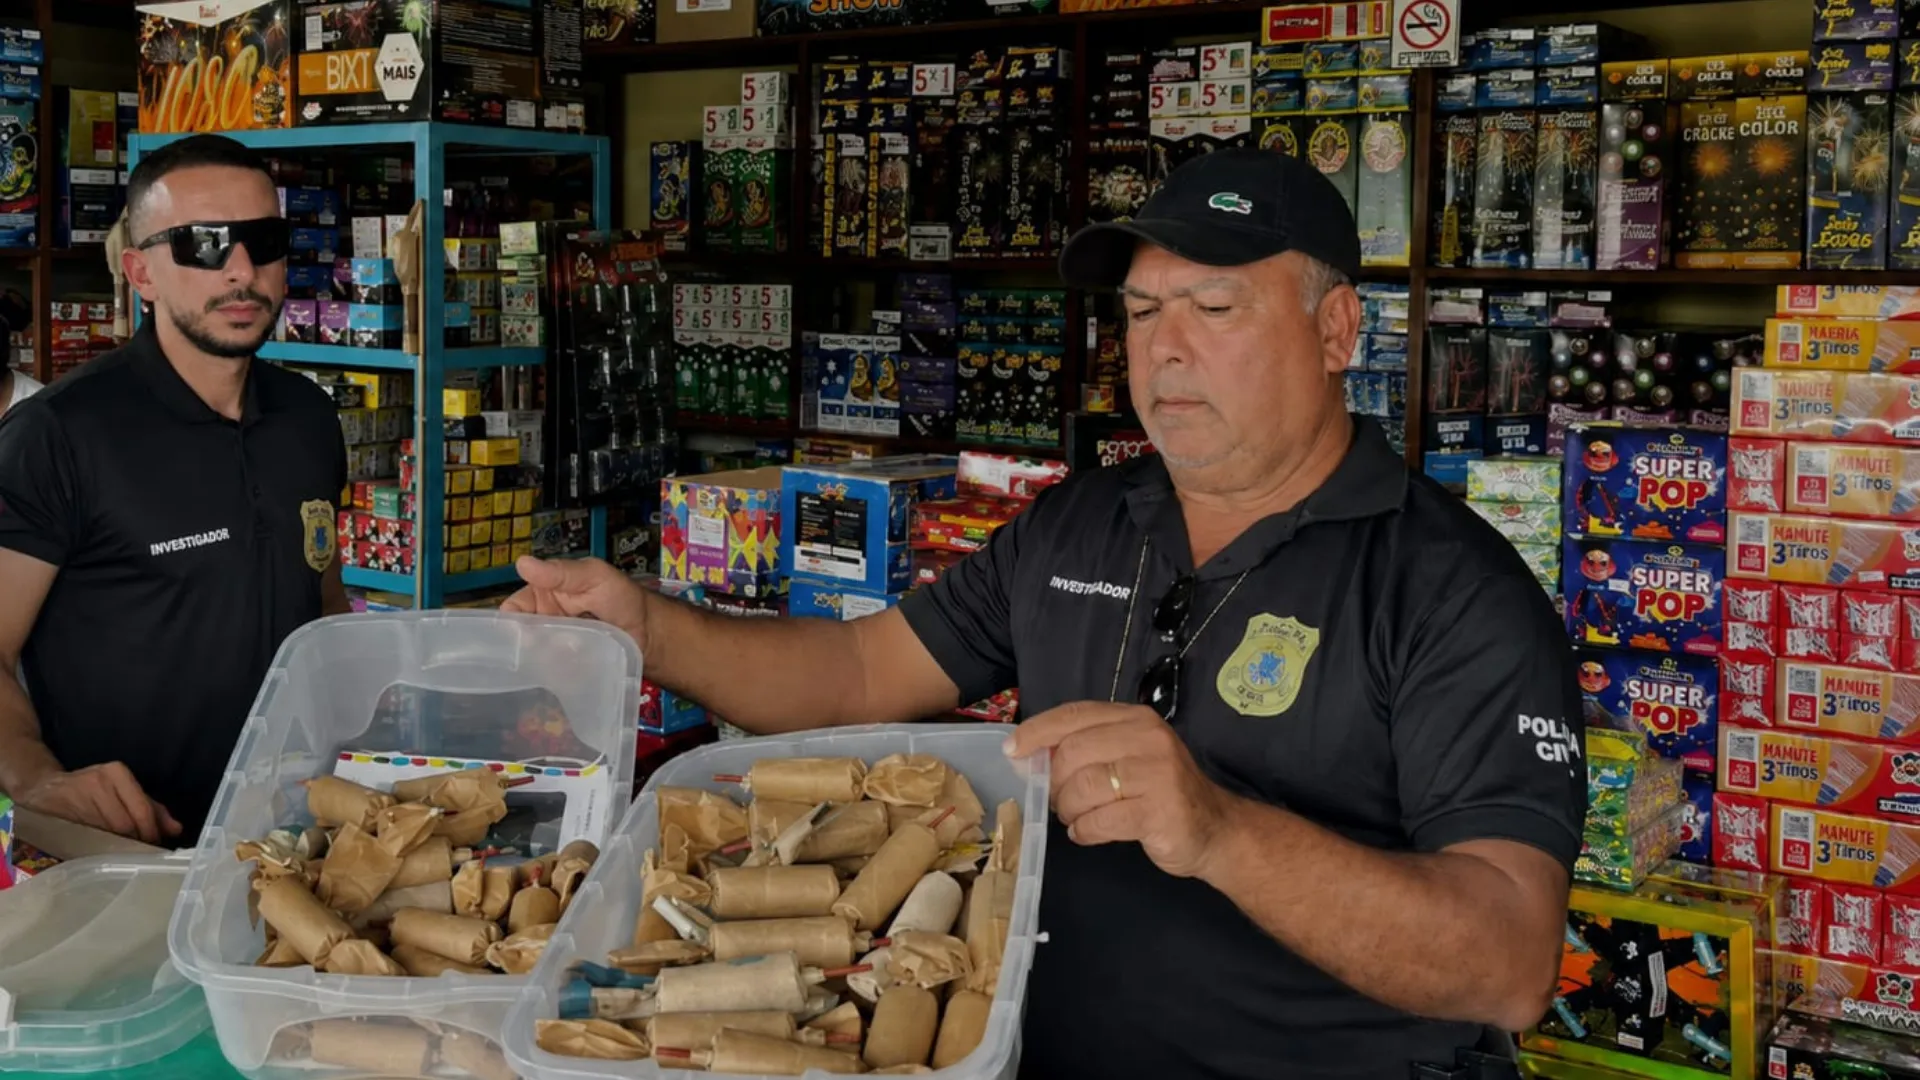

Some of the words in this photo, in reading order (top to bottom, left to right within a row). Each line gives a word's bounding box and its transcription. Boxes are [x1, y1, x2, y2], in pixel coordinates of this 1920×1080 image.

[326, 52, 371, 91] BIXT
[383, 64, 416, 80] MAIS
[1740, 120, 1798, 136] COLOR
[1806, 341, 1820, 361] 3
[1775, 399, 1789, 420] 3
[1636, 456, 1712, 479] SUPER
[1639, 478, 1707, 507] POP
[1833, 473, 1847, 496] 3
[150, 528, 230, 556] INVESTIGADOR
[1772, 543, 1787, 565] 3
[1633, 568, 1709, 592] SUPER
[1638, 589, 1705, 619] POP
[1628, 681, 1702, 706] SUPER
[1823, 694, 1836, 716] 3
[1633, 702, 1698, 733] POP
[1761, 760, 1776, 782] 3
[1817, 840, 1831, 863] 3
